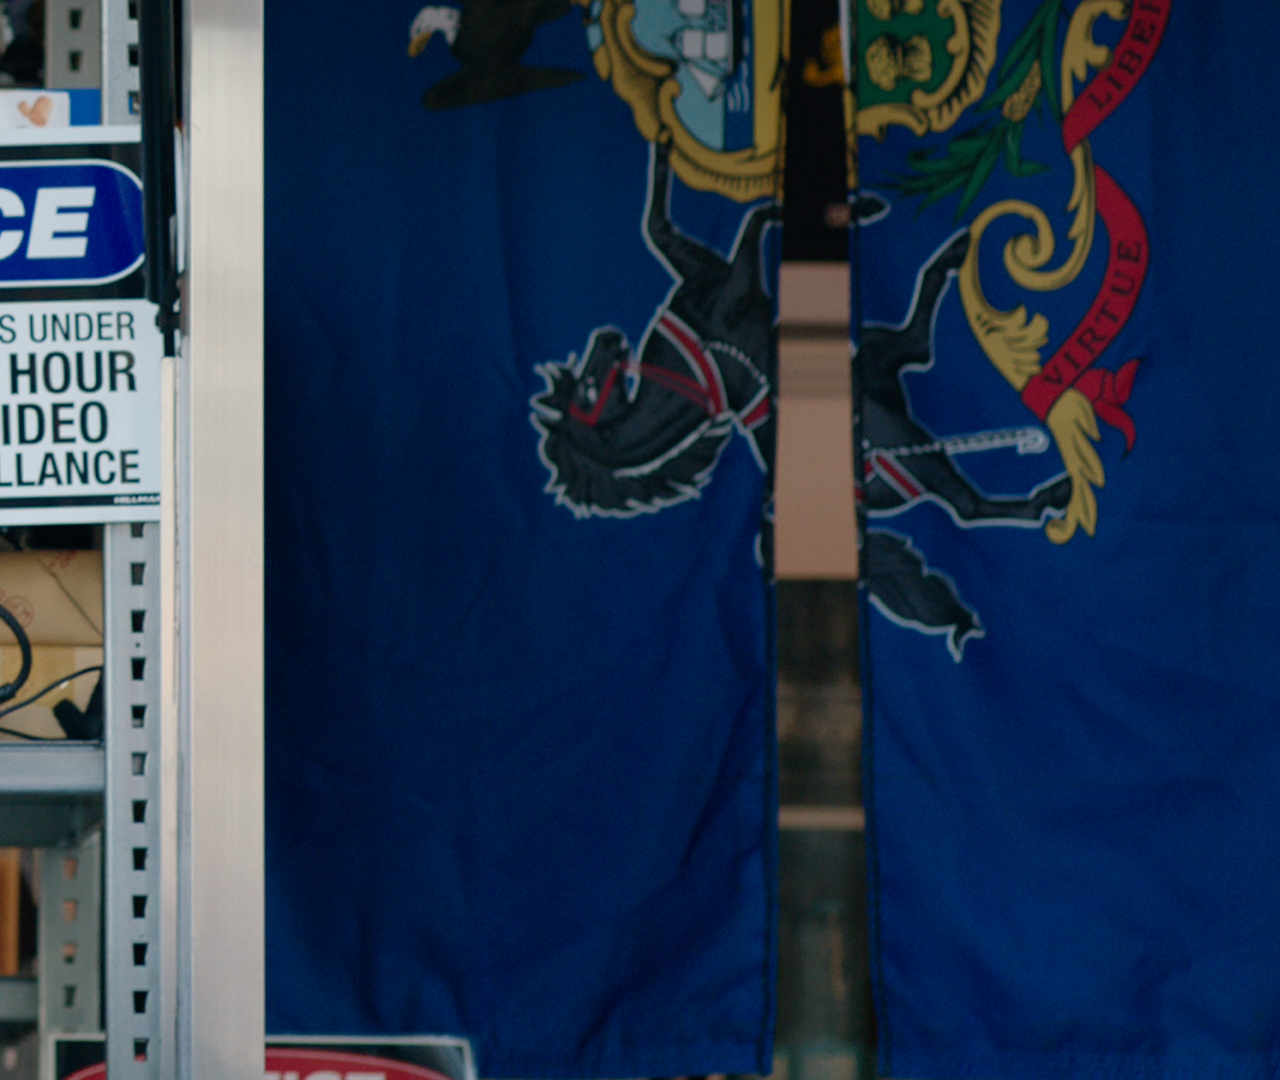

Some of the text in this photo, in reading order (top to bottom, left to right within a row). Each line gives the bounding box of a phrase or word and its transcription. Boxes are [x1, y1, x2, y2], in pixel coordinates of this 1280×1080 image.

[29, 312, 136, 344] UNDER
[1044, 240, 1140, 386] VIRTUE
[10, 351, 137, 395] HOUR
